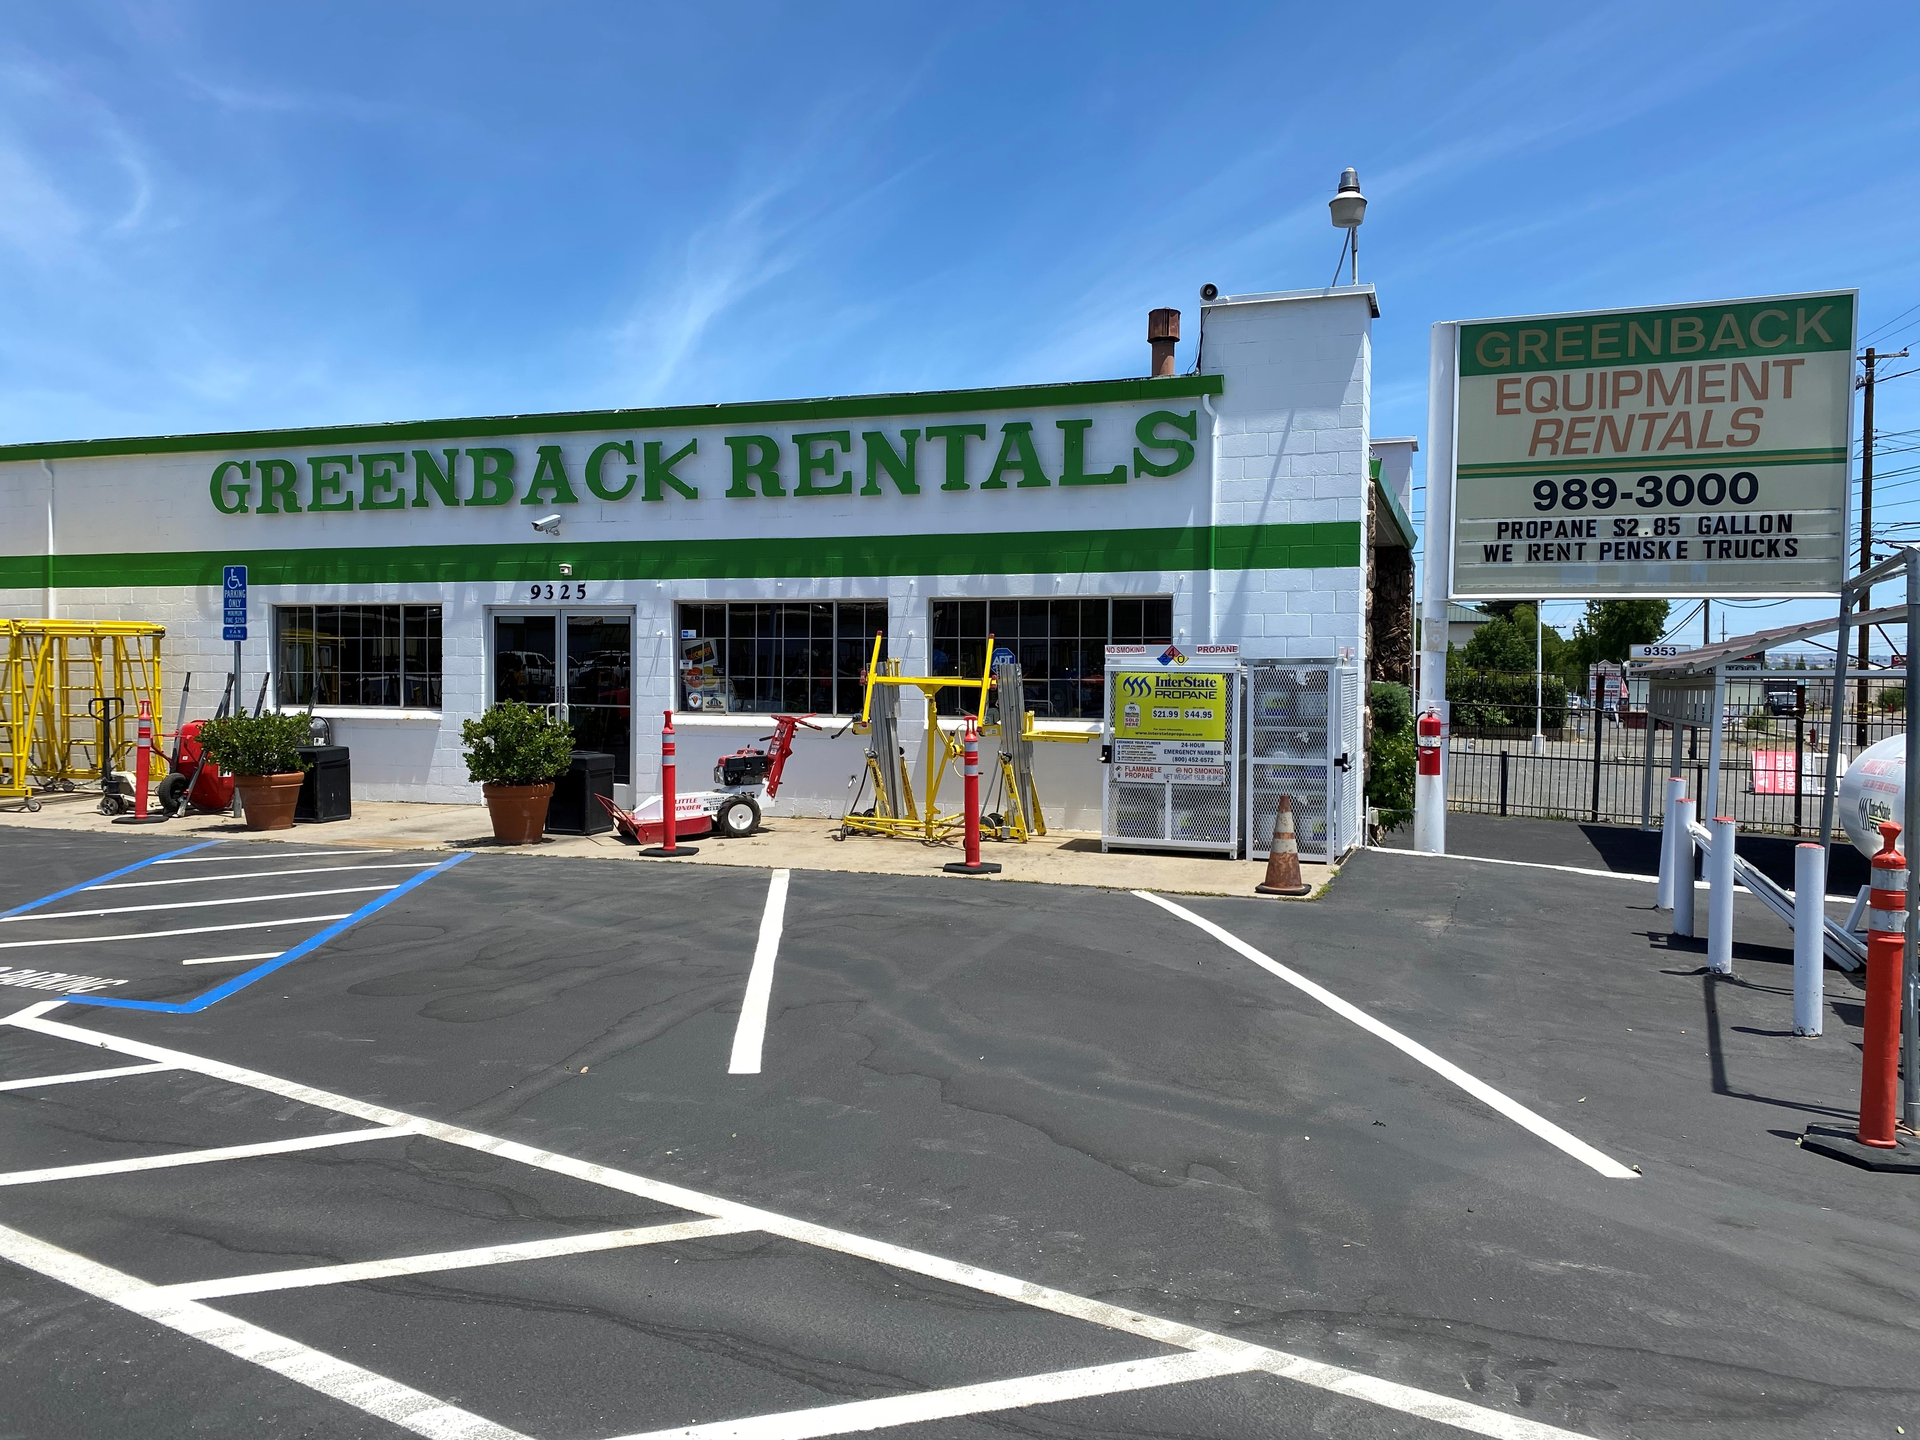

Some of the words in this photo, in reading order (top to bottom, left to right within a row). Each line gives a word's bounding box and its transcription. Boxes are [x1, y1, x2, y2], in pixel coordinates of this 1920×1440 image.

[1474, 304, 1834, 368] GREENBACK
[1495, 358, 1805, 416] EQUIPMENT
[1527, 406, 1764, 457] RENTALS
[209, 438, 699, 515] GREENBACK
[724, 410, 1197, 498] RENTALS
[1532, 471, 1760, 512] 989-3000
[1496, 519, 1598, 540] PROPANE
[1697, 513, 1793, 536] GALLON
[1484, 544, 1513, 563] WE
[1527, 542, 1588, 562] RENT
[1599, 540, 1688, 561] PENSKE
[1702, 537, 1799, 559] TRUCKS
[225, 589, 246, 598] PARKING
[530, 583, 587, 600] 9325
[228, 599, 242, 607] ONLY
[1168, 648, 1175, 659] 4
[1643, 646, 1677, 656] 9353
[992, 655, 1013, 666] ADT
[1177, 655, 1185, 663] 0
[1154, 676, 1217, 688] InterState
[1154, 690, 1217, 699] PROPANE
[1152, 710, 1179, 718] $21.99
[1184, 711, 1212, 719] $44.95
[1787, 776, 1795, 790] FOR
[0, 969, 129, 994] PARKING
